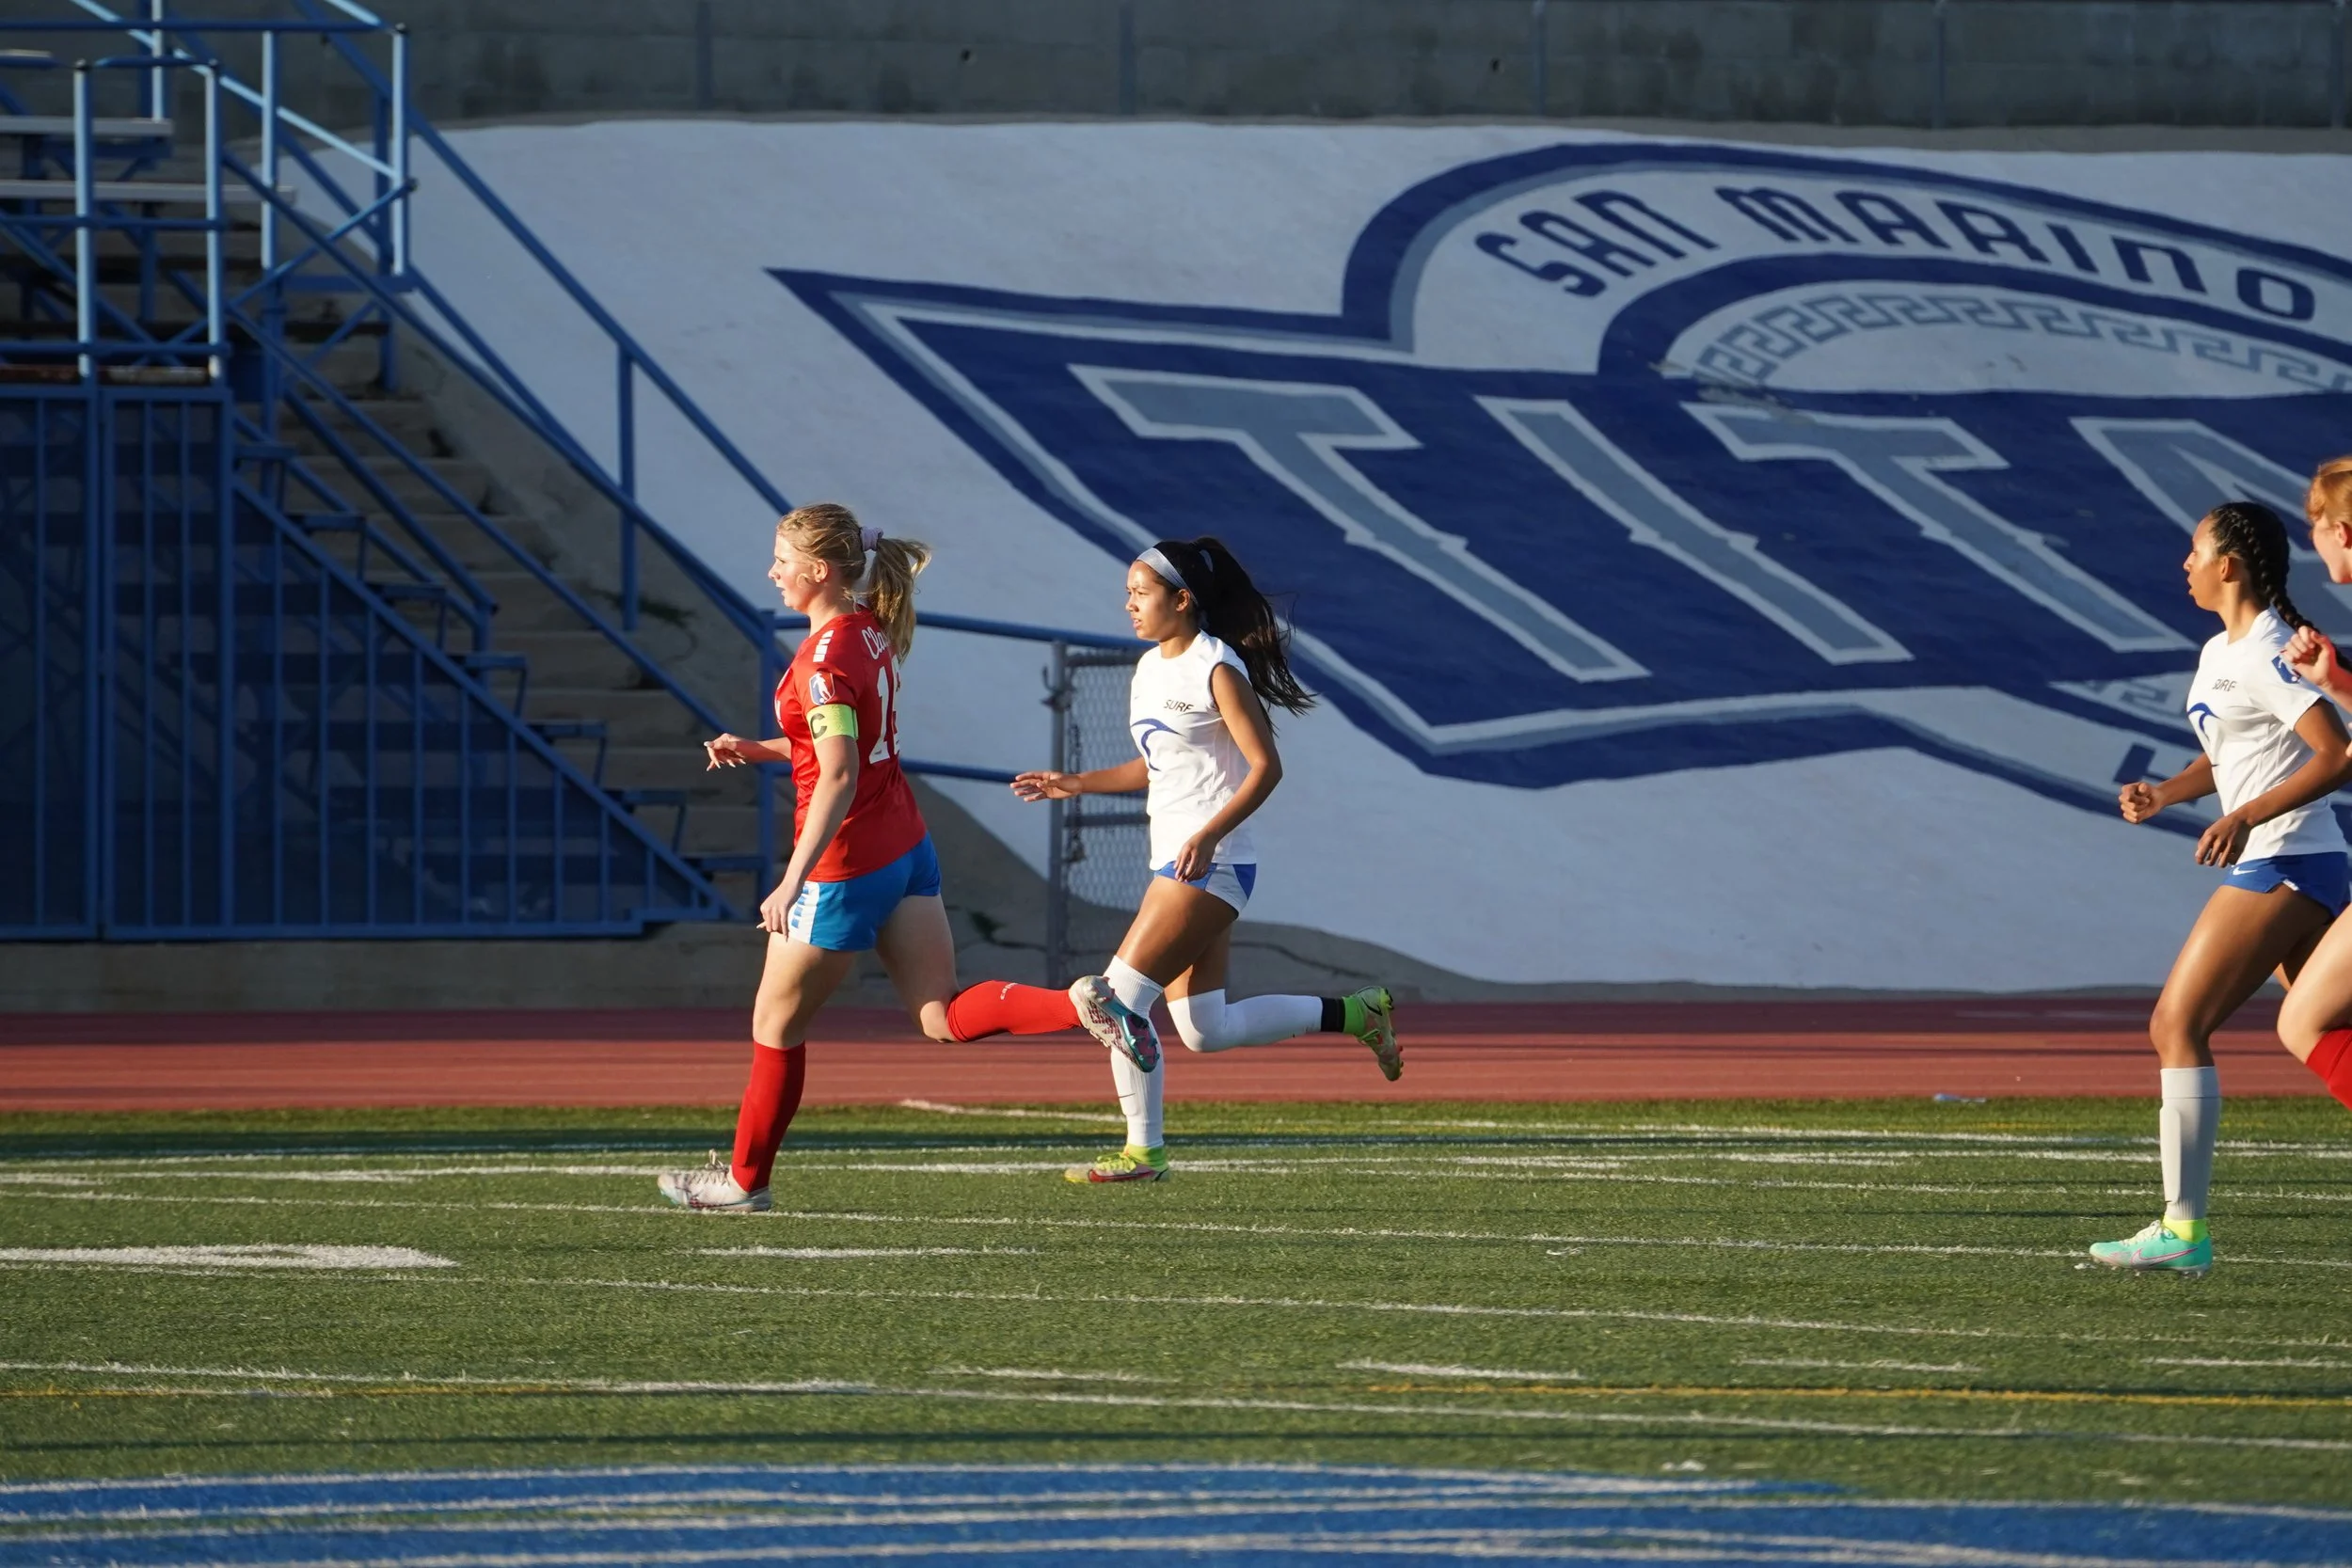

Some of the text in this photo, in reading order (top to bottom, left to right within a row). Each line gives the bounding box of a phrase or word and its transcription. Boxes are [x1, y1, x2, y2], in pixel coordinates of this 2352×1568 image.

[1474, 187, 2315, 322] SAN MARINO
[1163, 699, 1194, 713] SURF
[810, 713, 828, 739] C
